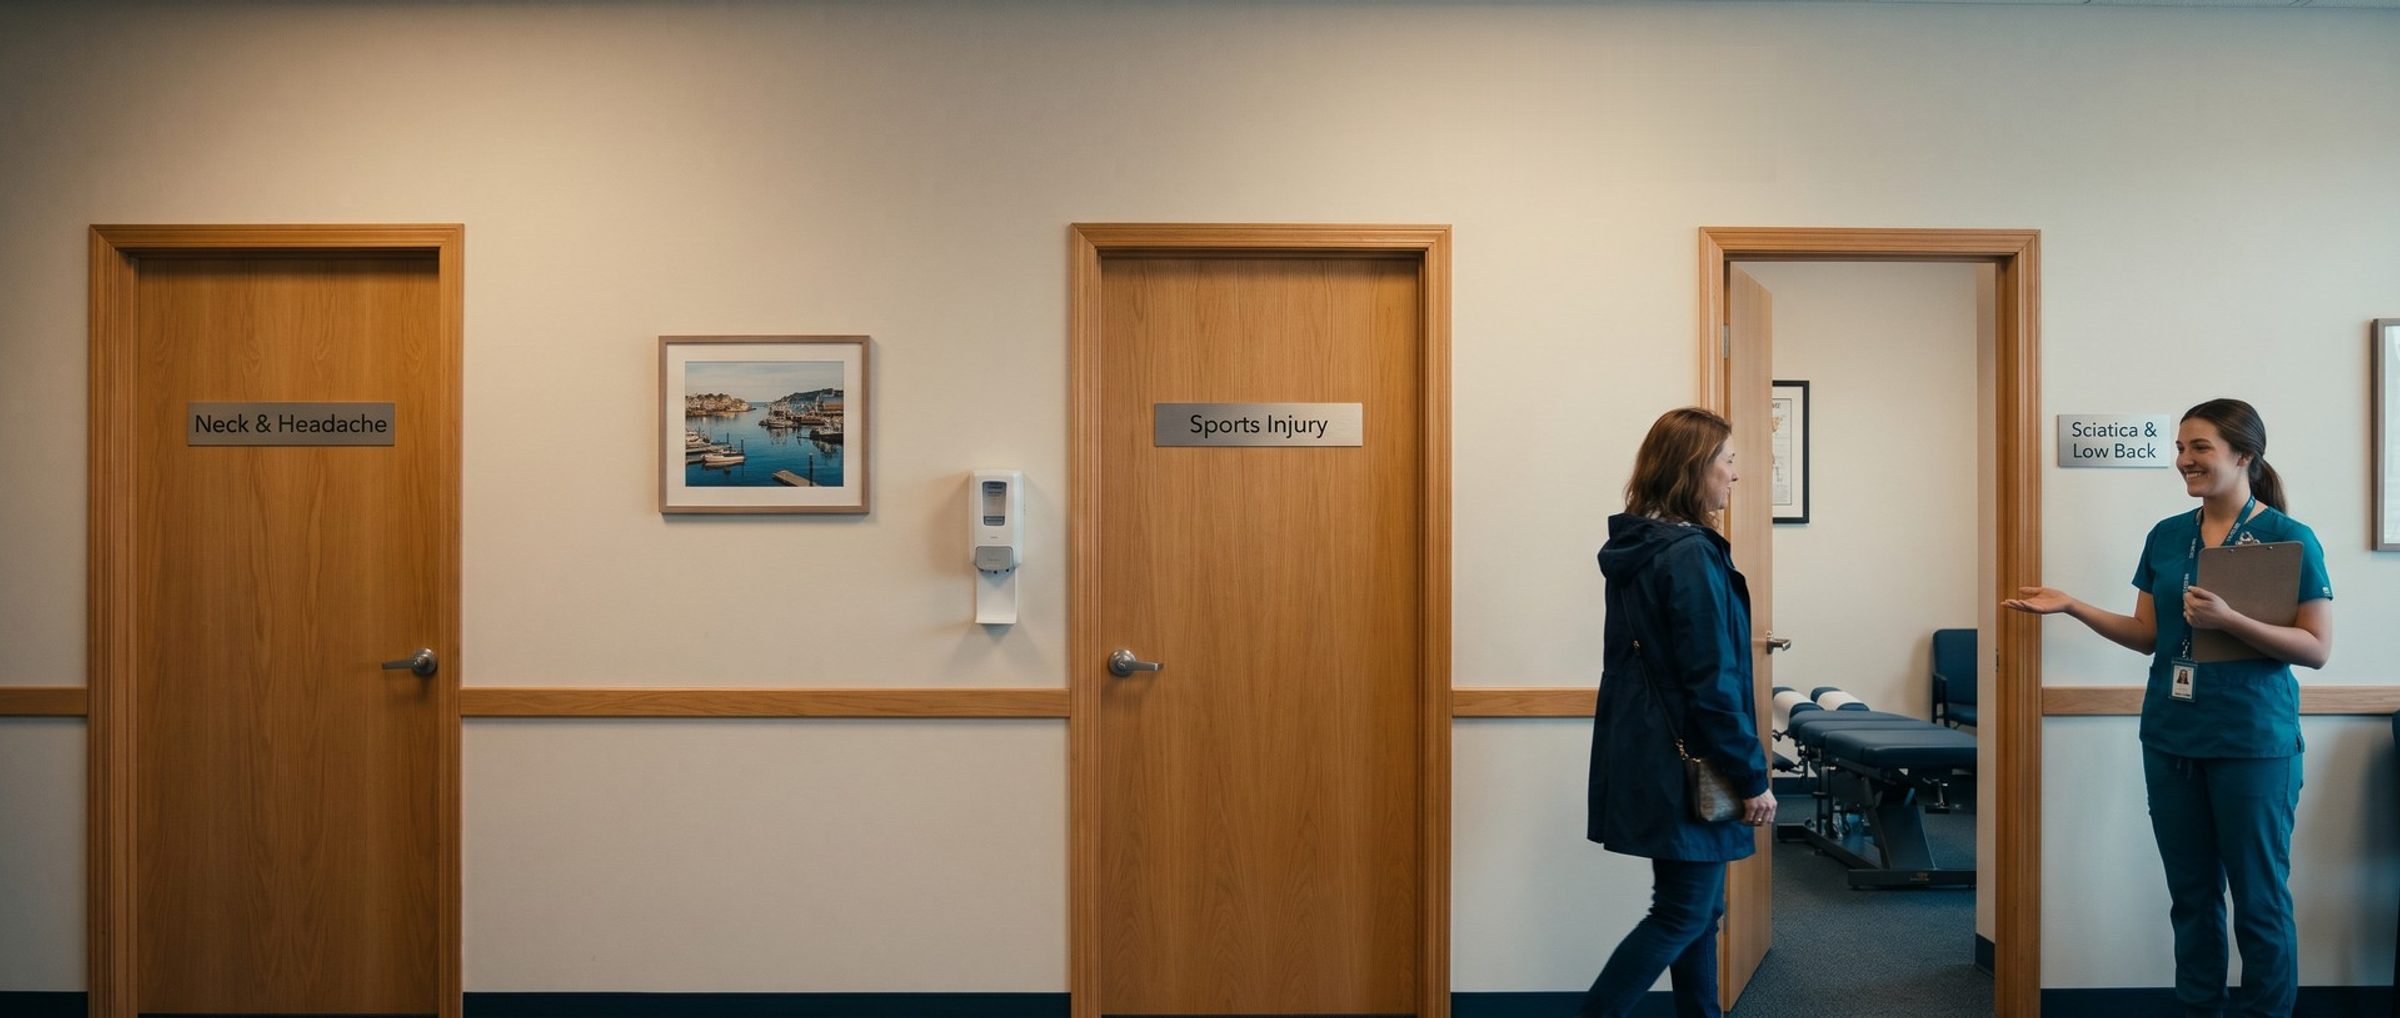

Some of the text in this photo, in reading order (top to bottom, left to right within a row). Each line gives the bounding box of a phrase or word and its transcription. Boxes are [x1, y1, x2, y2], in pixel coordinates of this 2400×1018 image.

[195, 414, 388, 433] Neck & Headache
[1190, 414, 1328, 439] Sports Injury
[2072, 421, 2157, 437] Sciatica &
[2073, 443, 2156, 458] Low Back
